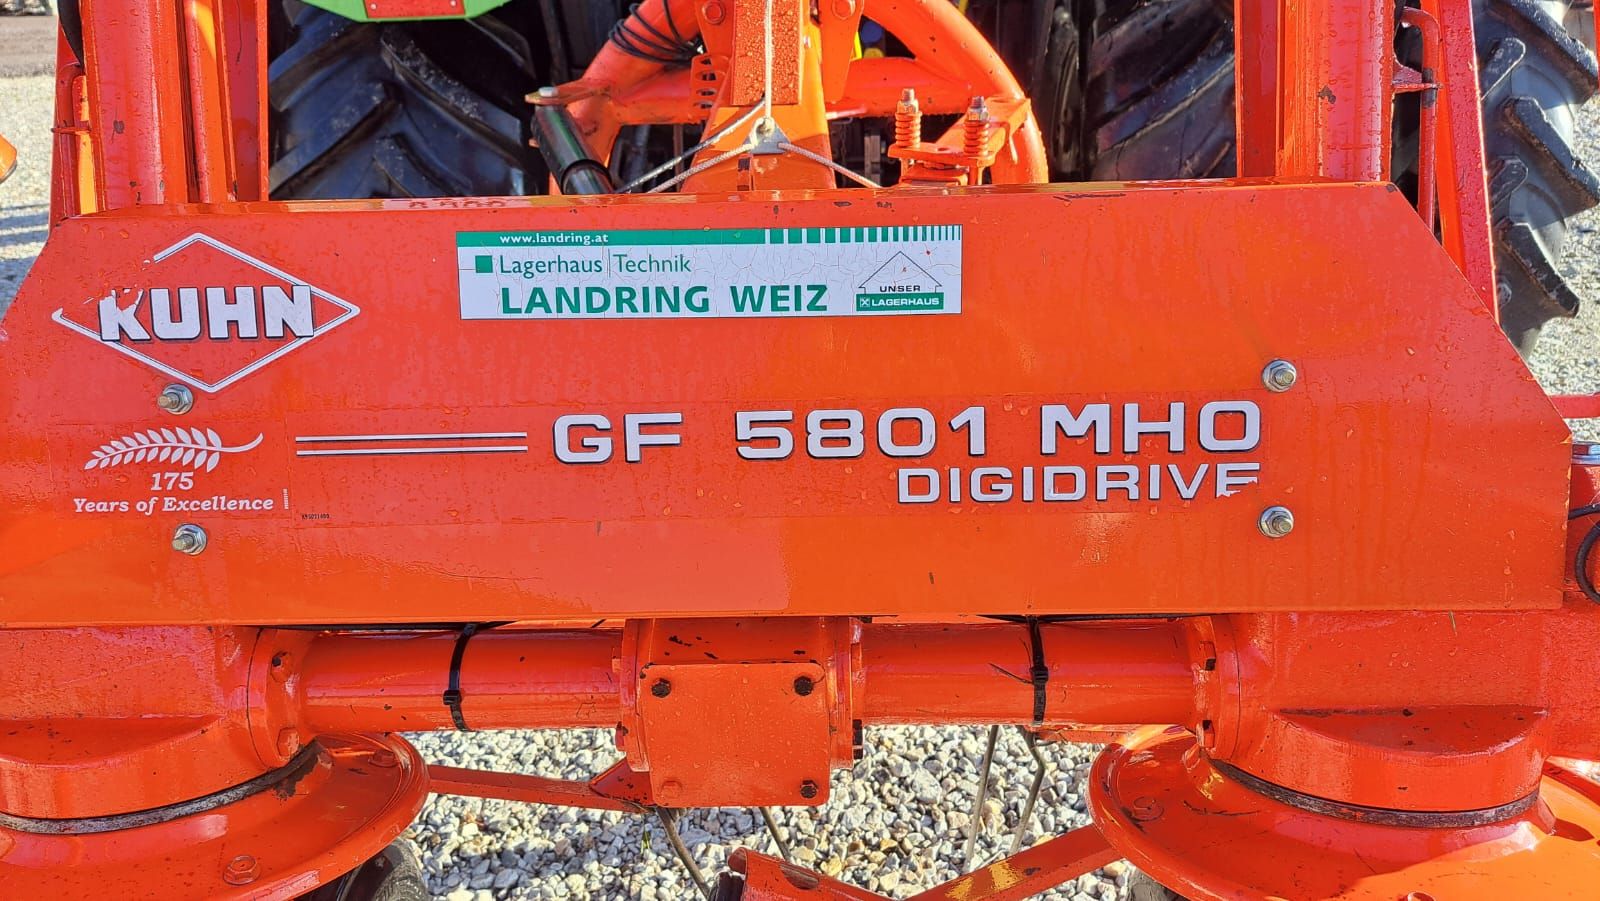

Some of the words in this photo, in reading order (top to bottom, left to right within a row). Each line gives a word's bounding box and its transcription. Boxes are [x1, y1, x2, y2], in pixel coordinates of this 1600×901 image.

[500, 232, 608, 246] www.landring.at
[500, 254, 602, 278] Lagerhaus
[613, 253, 691, 272] Technik
[501, 285, 709, 315] LANDRING
[729, 284, 828, 313] WEIZ
[879, 284, 921, 293] UNSER
[98, 285, 314, 341] KUHN
[871, 297, 940, 307] LAGERHAUS
[553, 412, 683, 464] GF
[735, 406, 987, 460] 5801
[1039, 400, 1262, 456] MHO
[151, 472, 194, 491] 175
[898, 462, 1260, 502] DIGIDRIVE
[73, 498, 129, 513] Years
[136, 496, 158, 516] of
[162, 495, 274, 512] Excellence
